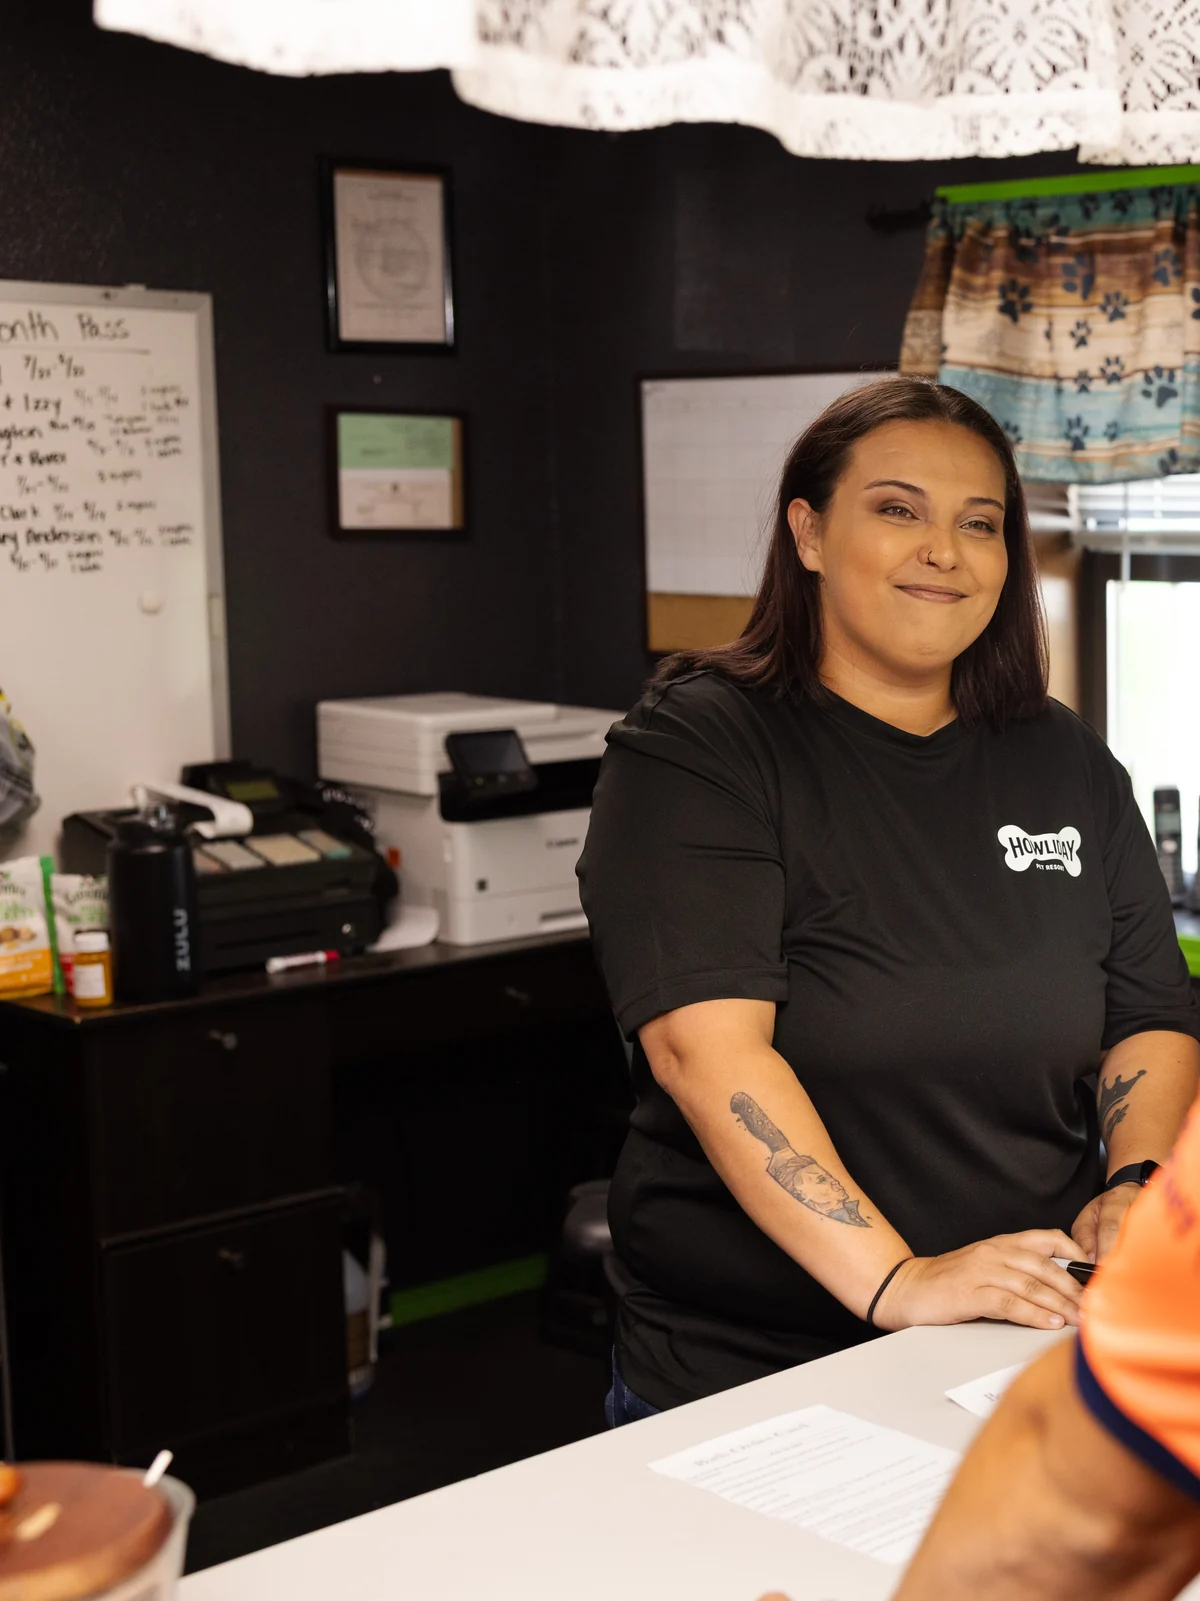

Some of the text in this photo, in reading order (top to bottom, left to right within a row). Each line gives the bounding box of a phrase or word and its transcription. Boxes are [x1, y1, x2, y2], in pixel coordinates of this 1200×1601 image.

[76, 312, 130, 340] Pass
[1008, 837, 1075, 861] HOWLIDAY
[172, 908, 191, 971] ZULU
